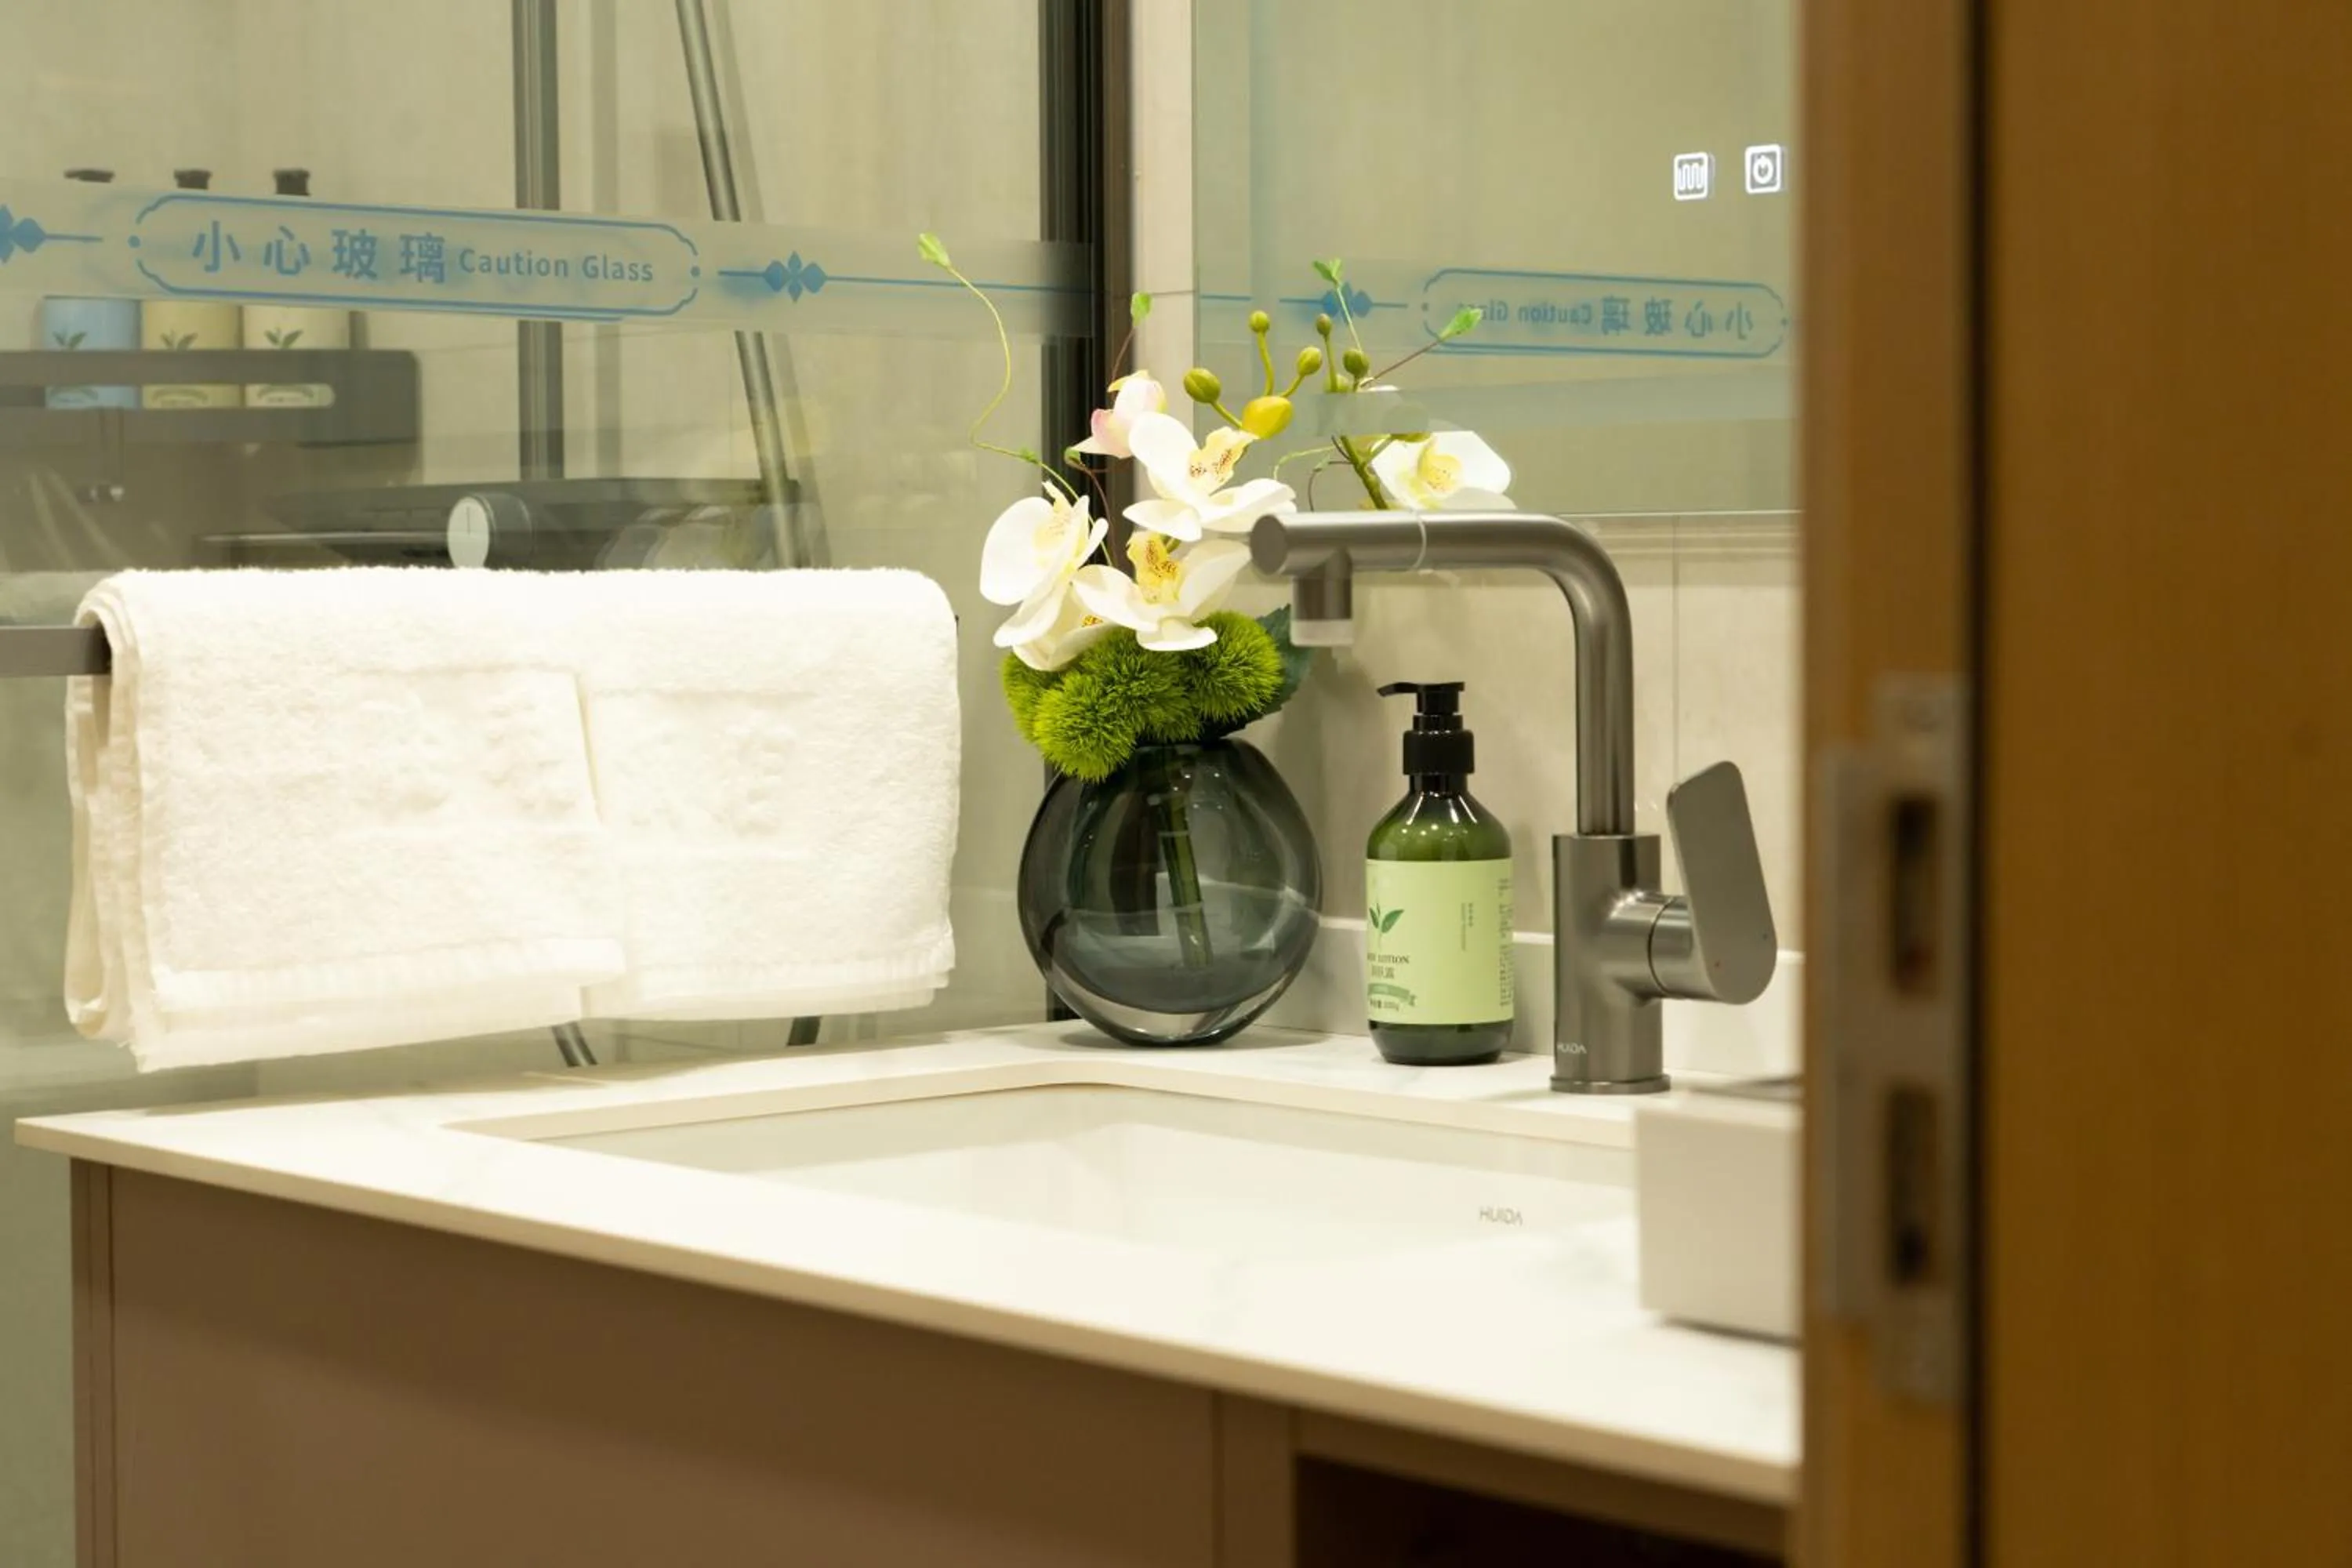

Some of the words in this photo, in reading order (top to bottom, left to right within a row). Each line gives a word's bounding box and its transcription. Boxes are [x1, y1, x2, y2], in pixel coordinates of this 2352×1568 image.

[192, 220, 445, 283] 小心玻璃
[459, 249, 569, 277] Caution
[582, 253, 654, 282] Glass
